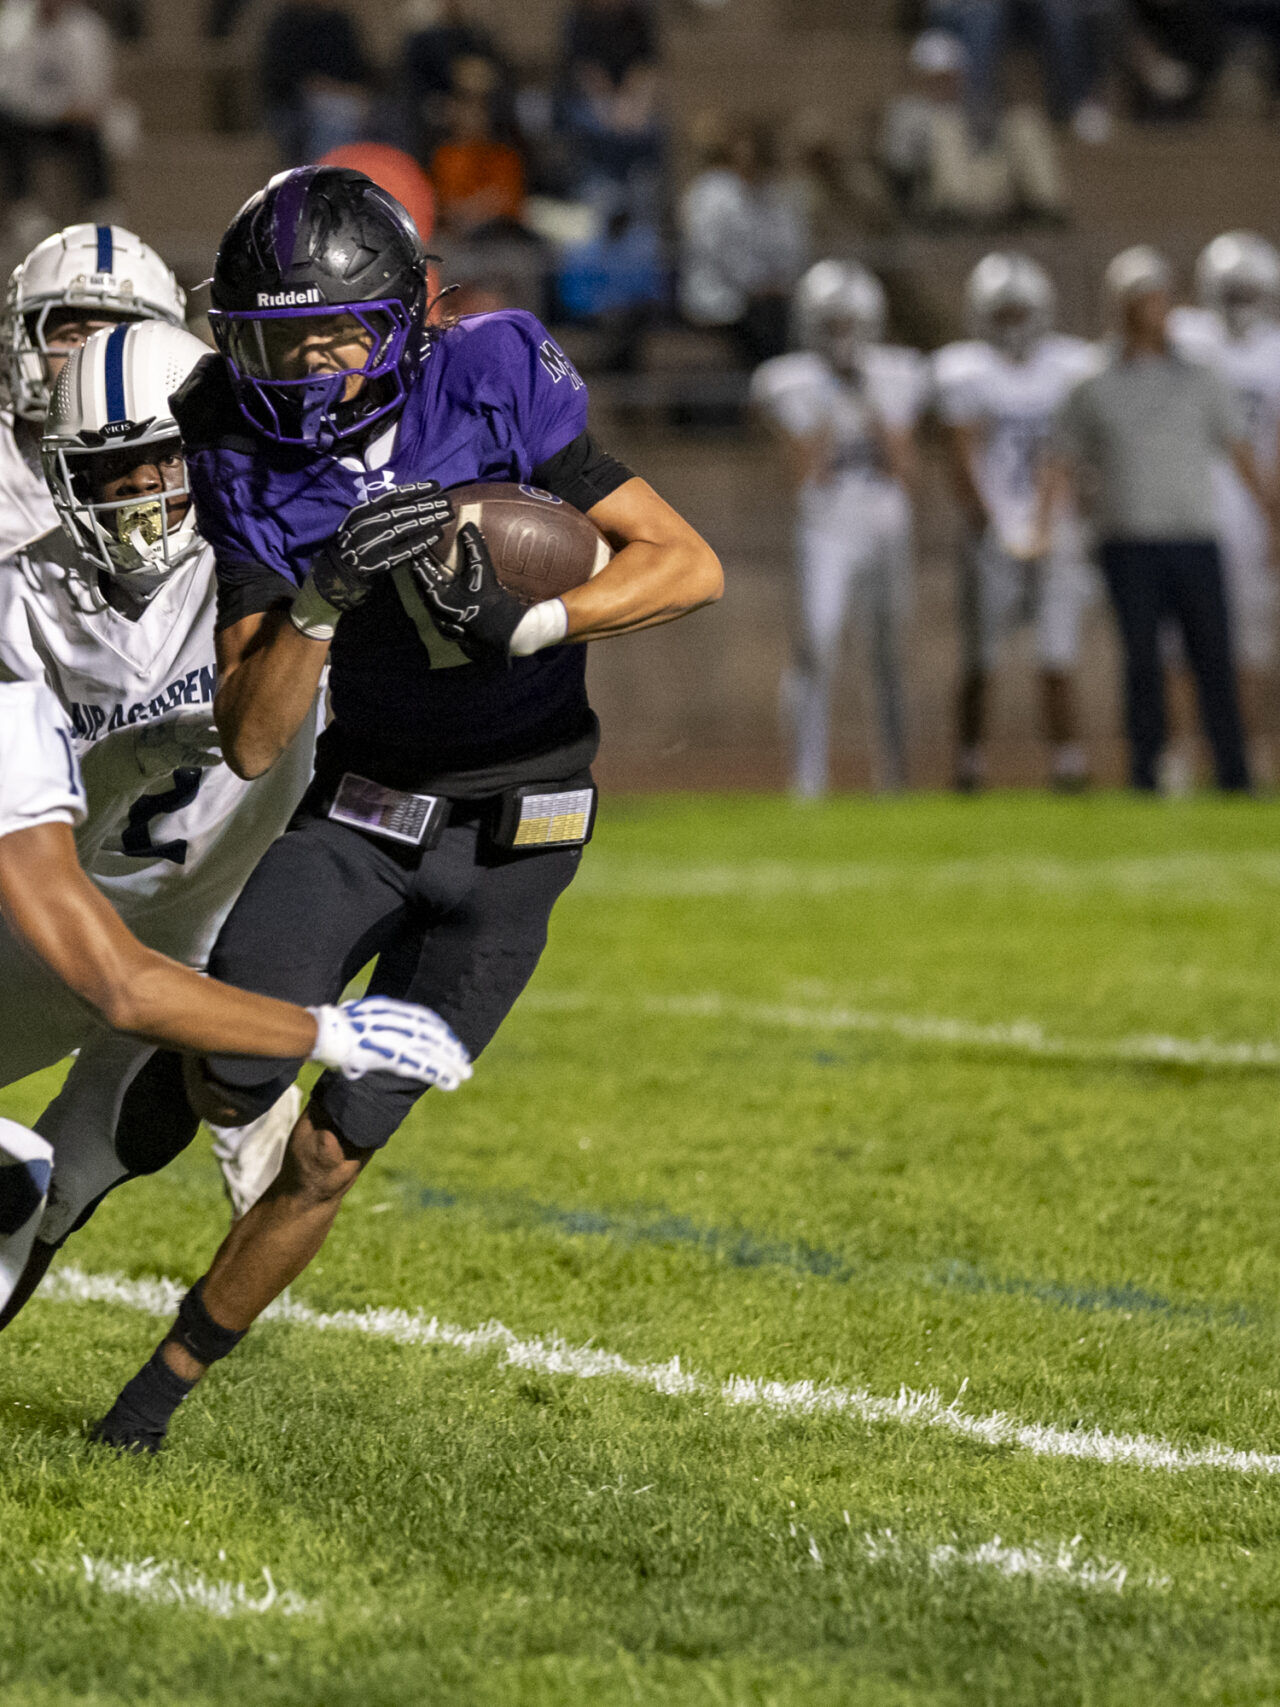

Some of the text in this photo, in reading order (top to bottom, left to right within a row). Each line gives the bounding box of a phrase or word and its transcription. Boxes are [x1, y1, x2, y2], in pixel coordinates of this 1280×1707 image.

[257, 288, 319, 307] Riddell
[104, 423, 131, 434] VICIS
[122, 766, 202, 866] 2
